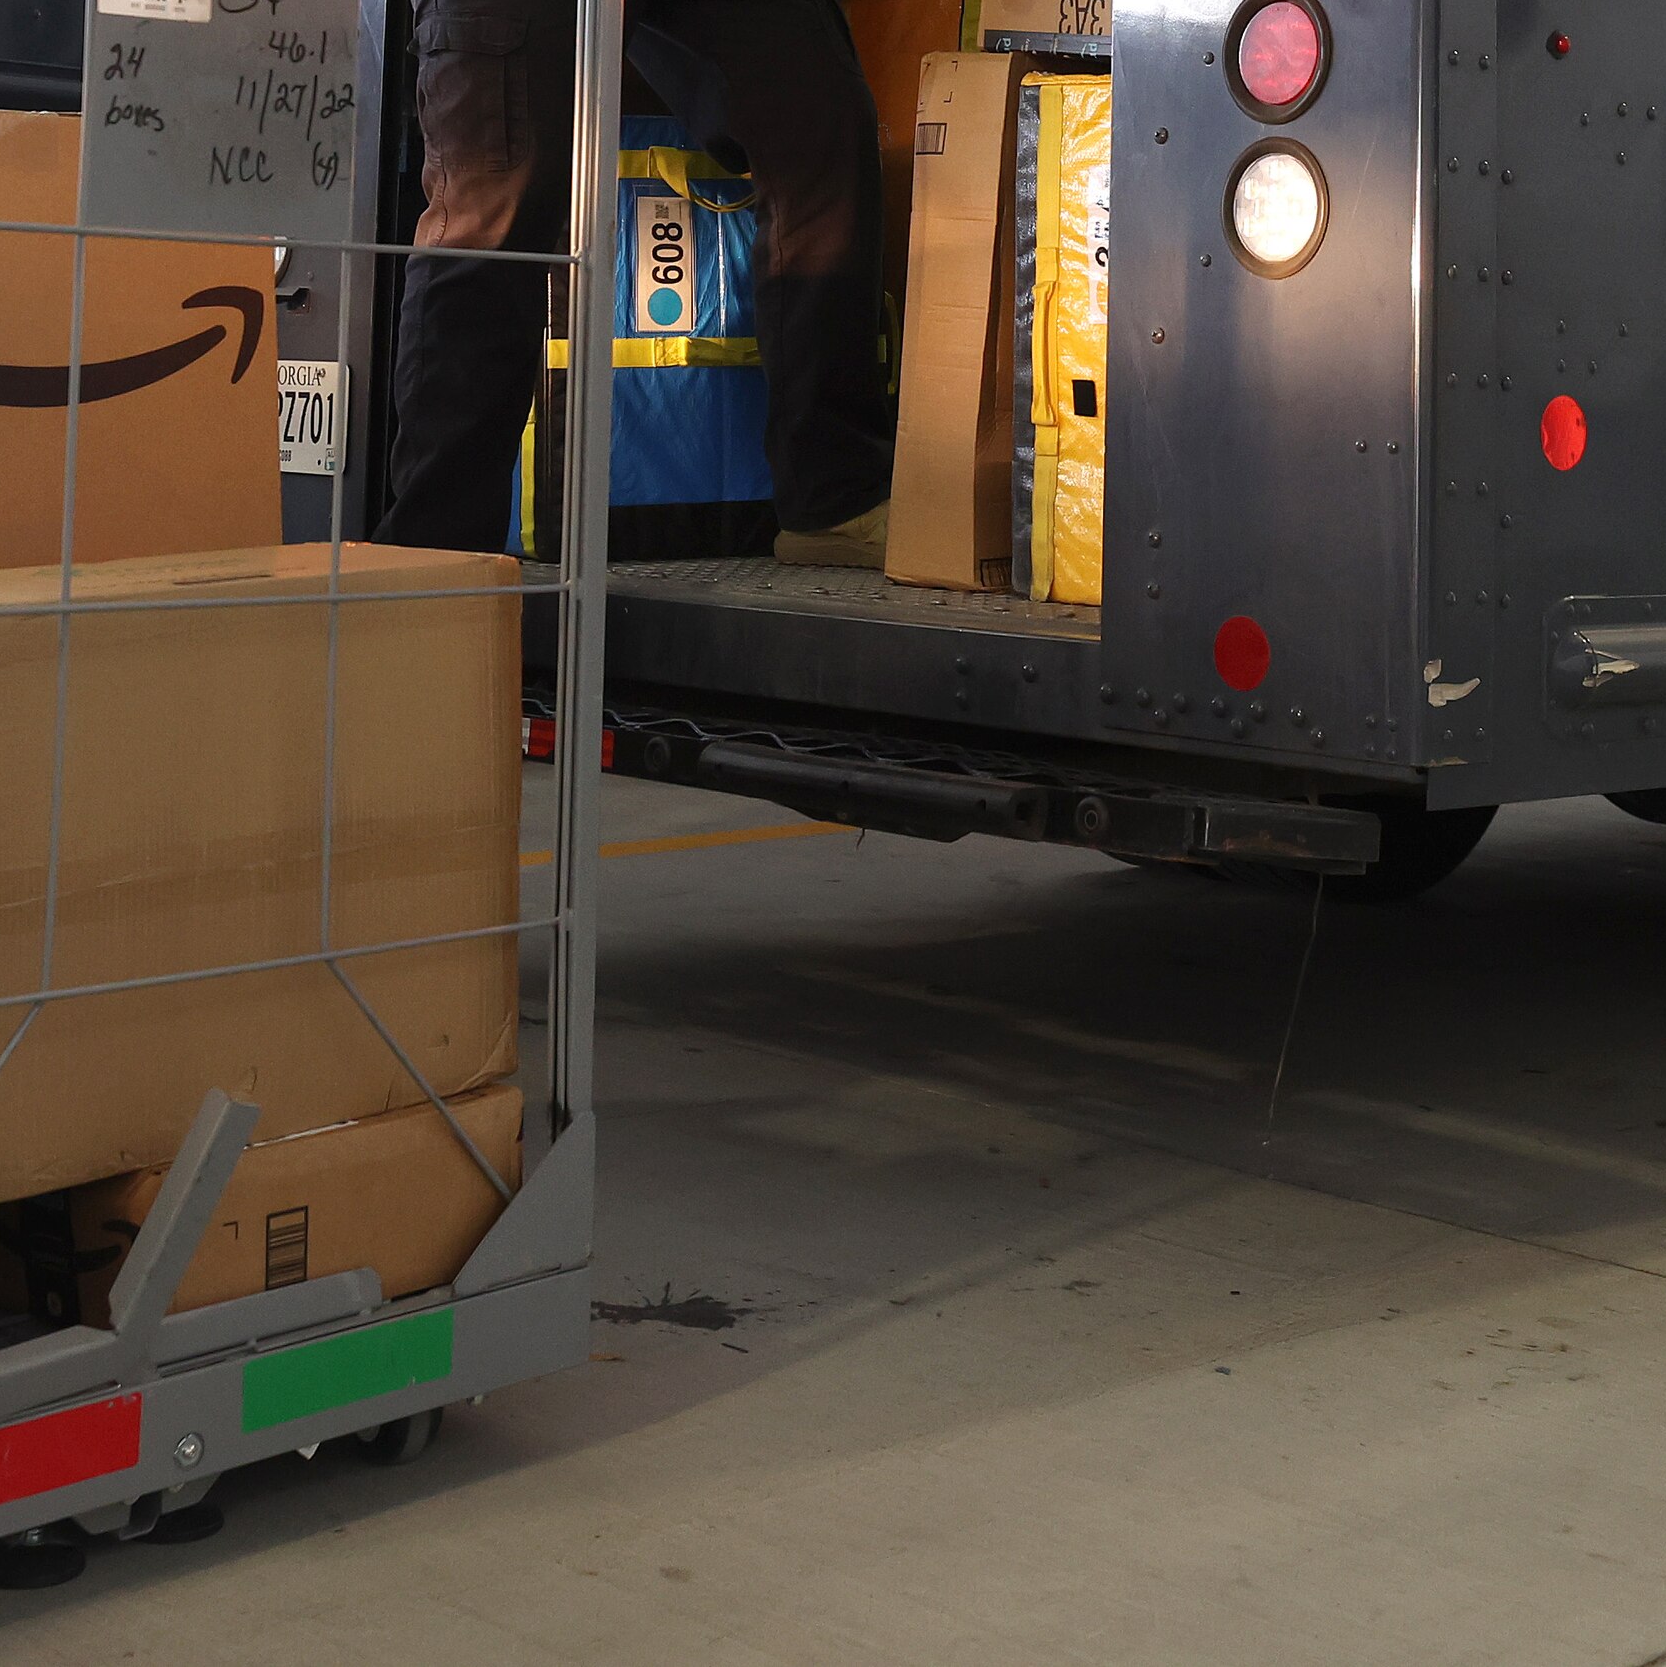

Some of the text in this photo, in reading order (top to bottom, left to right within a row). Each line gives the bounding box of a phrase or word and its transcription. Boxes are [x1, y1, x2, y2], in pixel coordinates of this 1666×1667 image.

[104, 43, 145, 80] 24
[269, 31, 327, 64] 46.1
[236, 69, 355, 141] 11/27/22
[652, 222, 683, 284] 608
